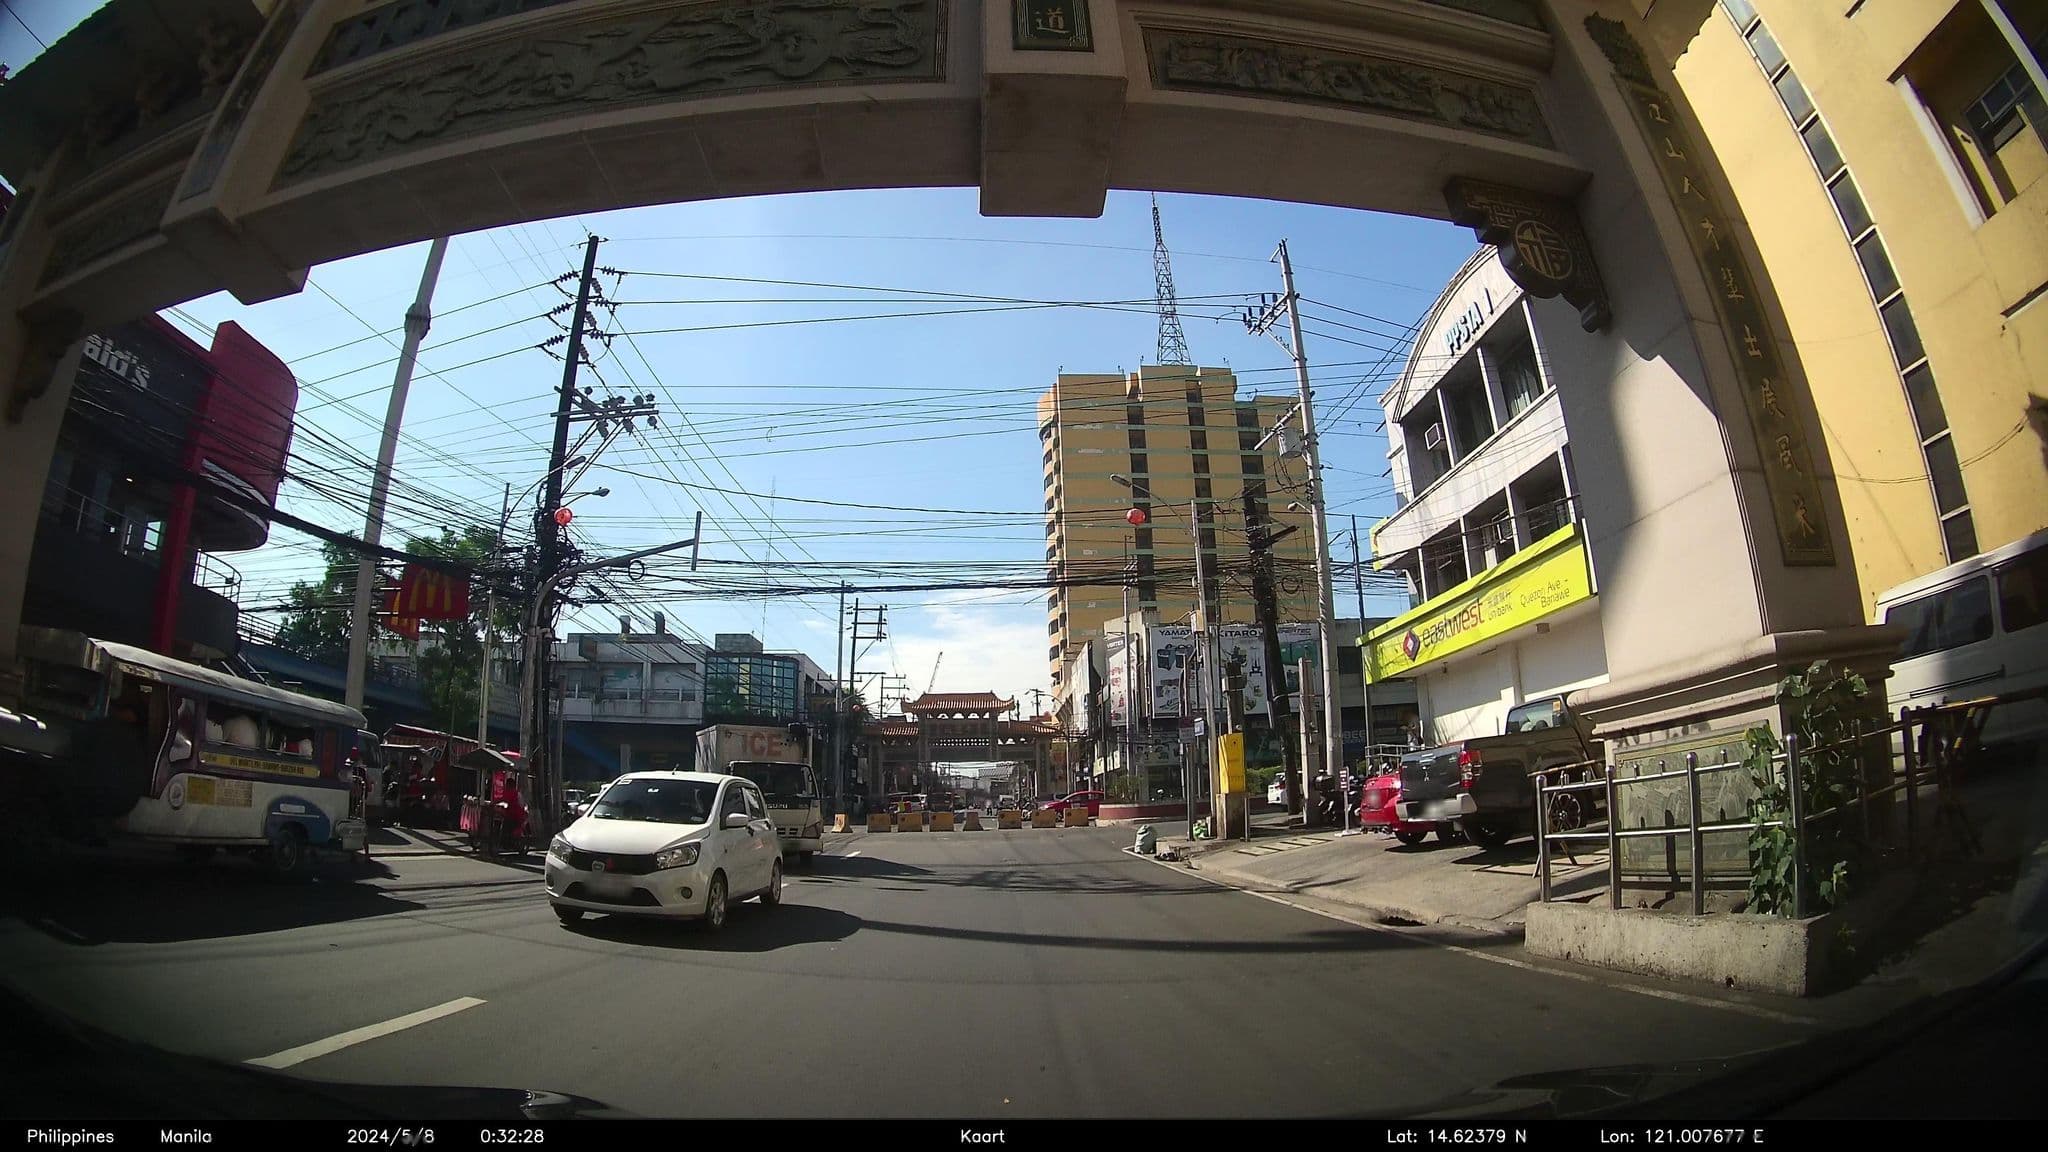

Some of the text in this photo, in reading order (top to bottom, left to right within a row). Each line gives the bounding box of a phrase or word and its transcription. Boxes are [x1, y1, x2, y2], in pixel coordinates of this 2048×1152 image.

[1540, 588, 1570, 608] Banawe
[1422, 601, 1485, 648] eastwest
[742, 732, 782, 757] ICE
